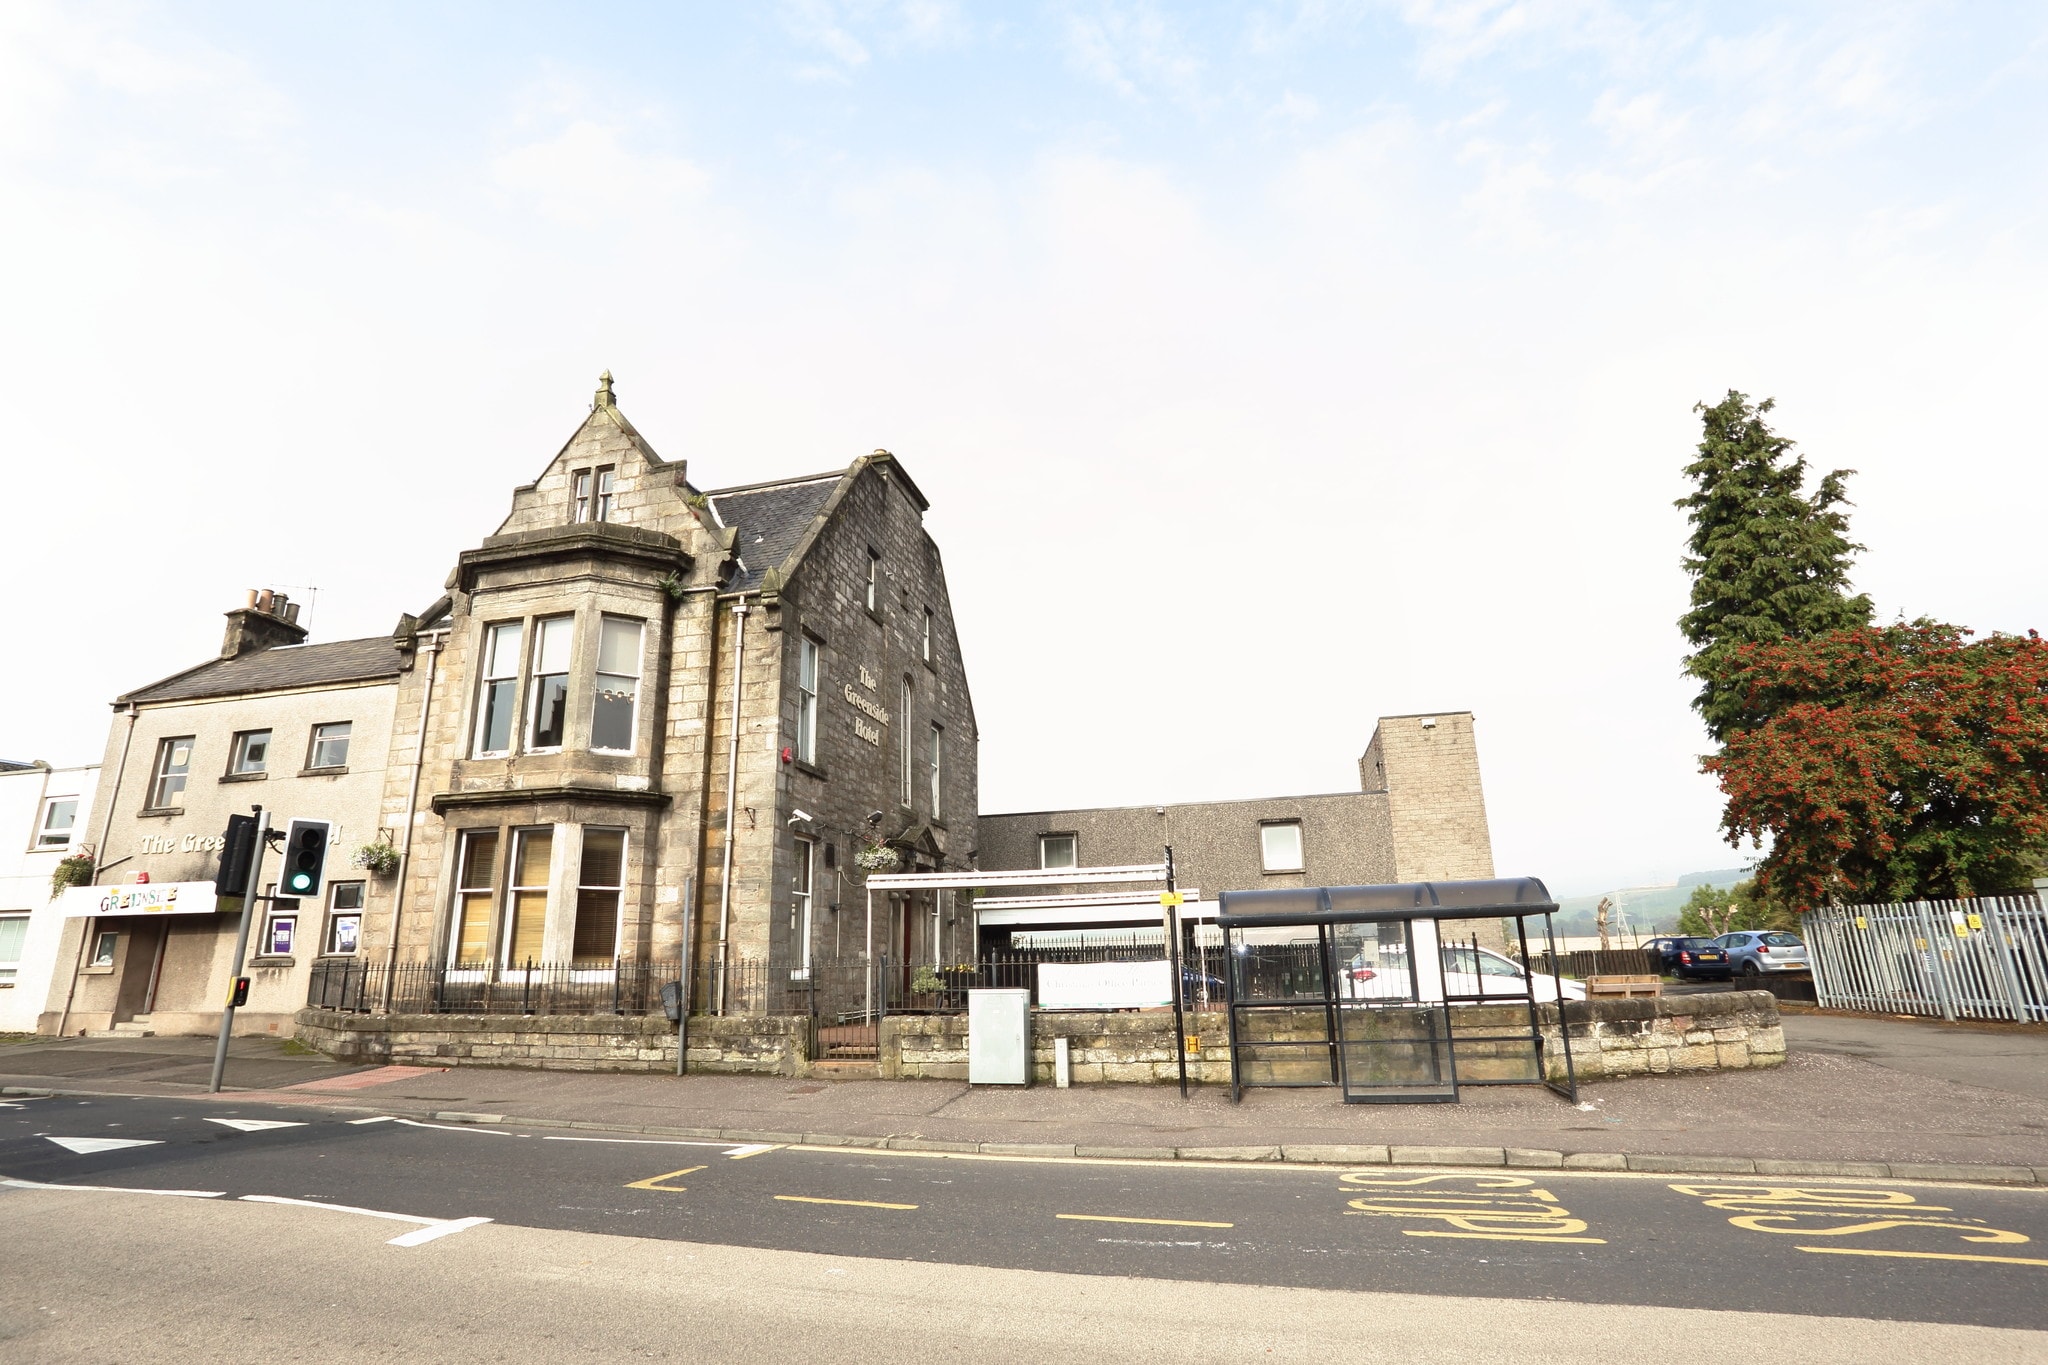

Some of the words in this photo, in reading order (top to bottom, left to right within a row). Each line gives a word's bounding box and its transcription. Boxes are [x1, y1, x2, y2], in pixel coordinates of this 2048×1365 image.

[859, 664, 877, 692] The
[844, 683, 889, 727] Greenside
[855, 716, 880, 747] Hotel
[141, 834, 176, 855] The
[1187, 1037, 1199, 1051] H
[1337, 1172, 1588, 1235] STOP
[1667, 1183, 2031, 1244] BUS
